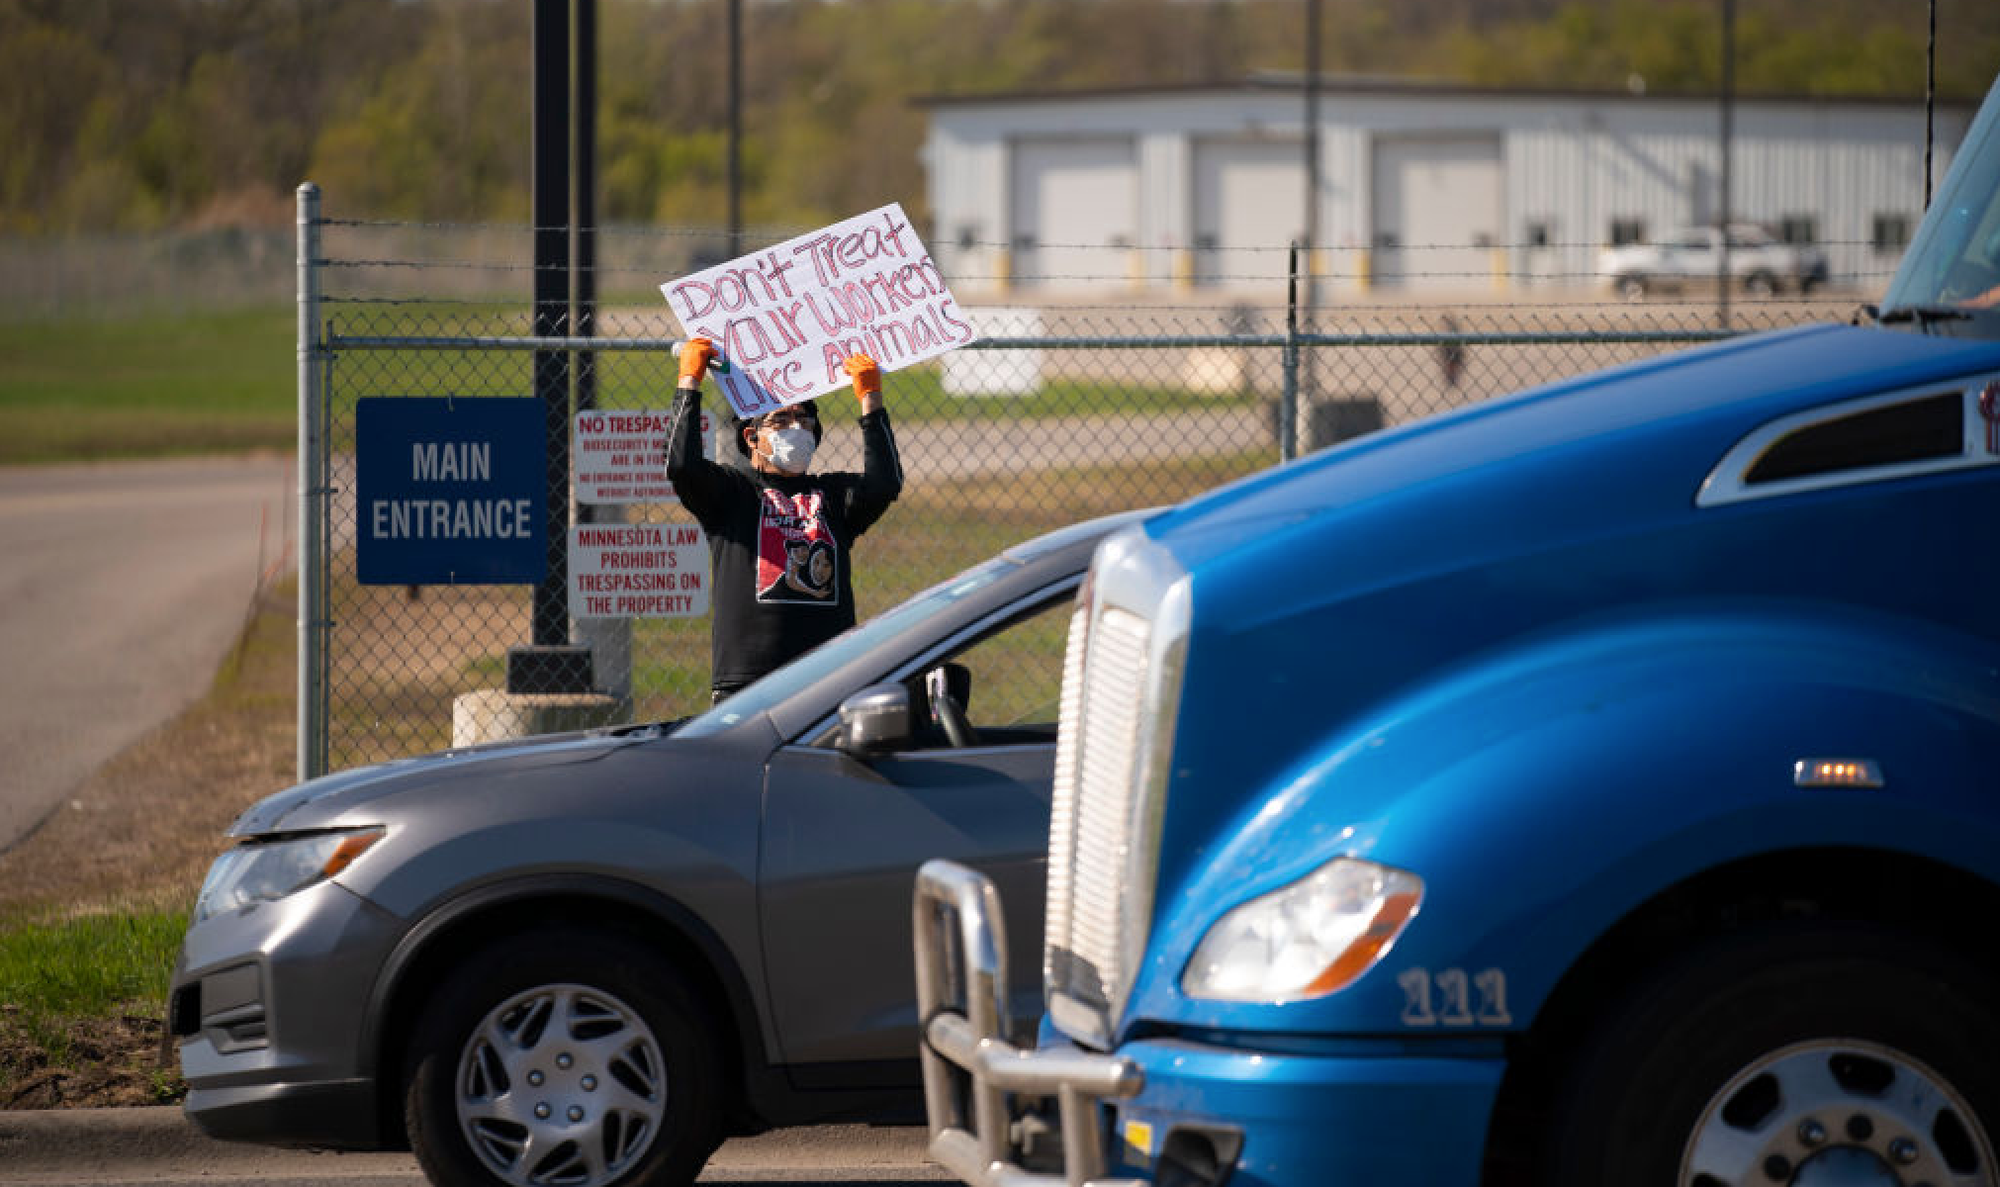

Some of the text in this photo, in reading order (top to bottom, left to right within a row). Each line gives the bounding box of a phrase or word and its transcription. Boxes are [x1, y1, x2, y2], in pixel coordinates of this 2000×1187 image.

[672, 213, 907, 321] Don't Treat
[579, 415, 709, 434] NO TRESPAG
[412, 442, 491, 481] MAIN
[372, 498, 533, 539] ENTRANCE
[578, 527, 699, 547] MINNESOTA LAW
[601, 551, 677, 569] PROHIBITS
[578, 572, 701, 592] TRESPASSING ON
[586, 595, 693, 614] THE PROPERTY
[1397, 966, 1513, 1026] 111
